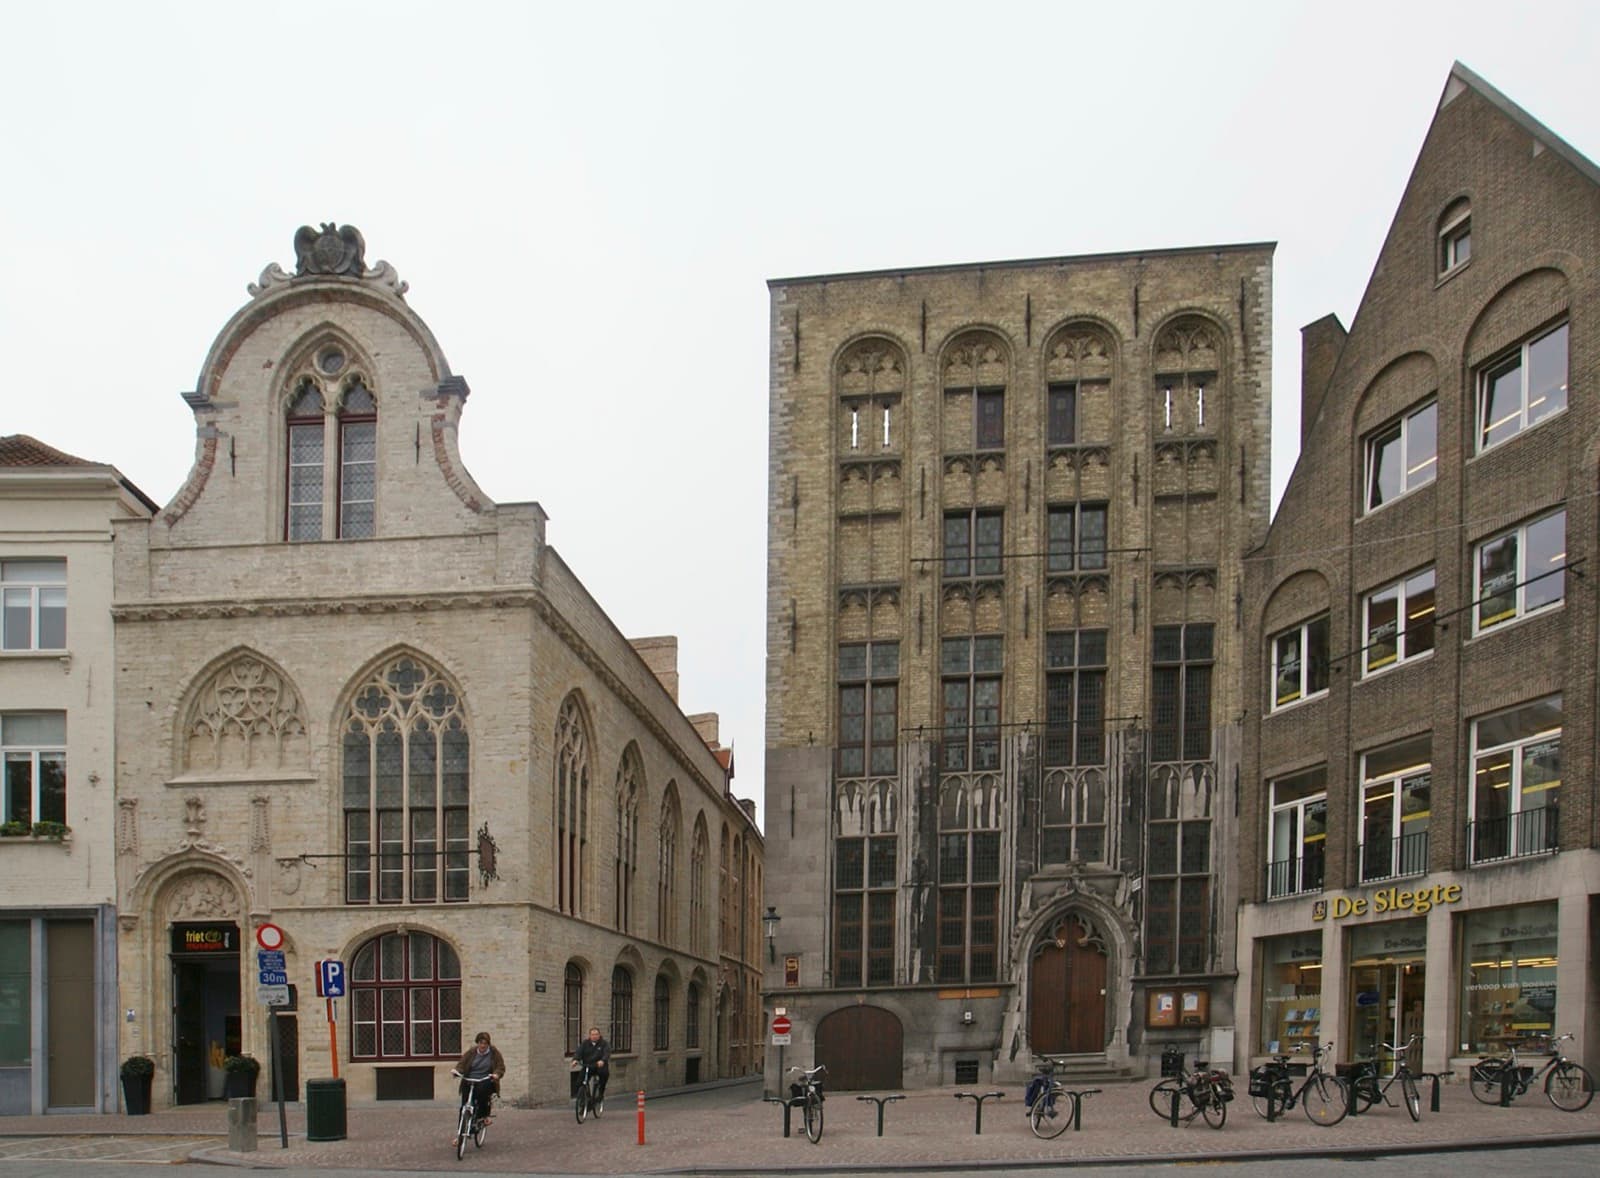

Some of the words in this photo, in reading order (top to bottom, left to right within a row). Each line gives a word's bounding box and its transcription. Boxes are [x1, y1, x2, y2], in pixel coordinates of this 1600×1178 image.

[1332, 896, 1367, 918] De
[1374, 884, 1462, 914] Slegte
[185, 930, 205, 943] friet
[328, 963, 340, 983] P
[1465, 983, 1500, 991] verkoop
